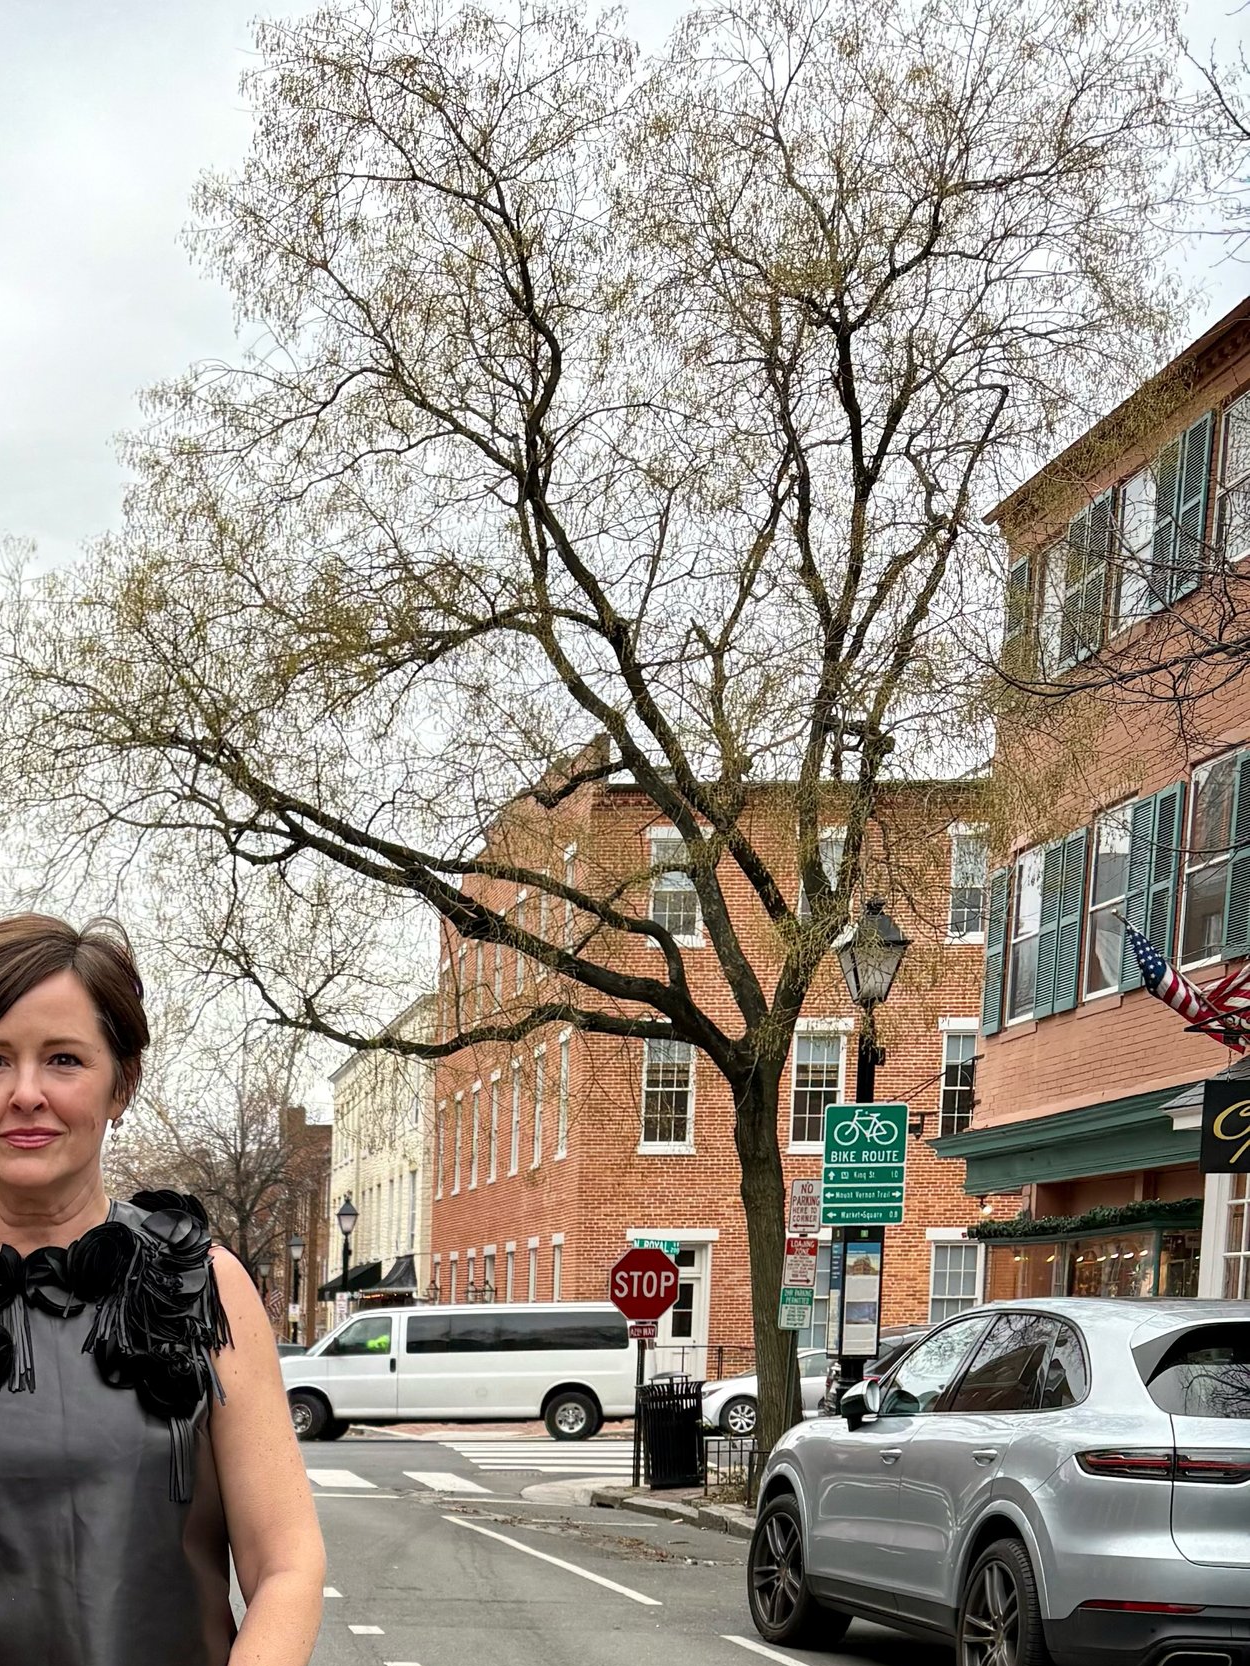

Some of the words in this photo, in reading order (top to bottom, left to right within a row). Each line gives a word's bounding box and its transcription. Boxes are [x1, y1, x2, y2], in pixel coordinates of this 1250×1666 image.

[830, 1150, 857, 1162] BIKE
[862, 1150, 899, 1162] ROUTE
[853, 1171, 867, 1180] King
[800, 1183, 814, 1194] NO
[835, 1191, 853, 1199] Mount
[855, 1191, 875, 1199] Vernon
[876, 1190, 891, 1198] Trail
[792, 1195, 820, 1206] PARKING
[793, 1206, 808, 1214] HERE
[810, 1206, 818, 1214] TO
[792, 1214, 818, 1223] CORNER
[633, 1239, 640, 1248] N
[643, 1240, 669, 1253] ROYAL
[790, 1240, 815, 1249] LOADING
[794, 1247, 810, 1256] ZONE
[614, 1270, 675, 1298] STOP
[643, 1327, 655, 1336] WAY
